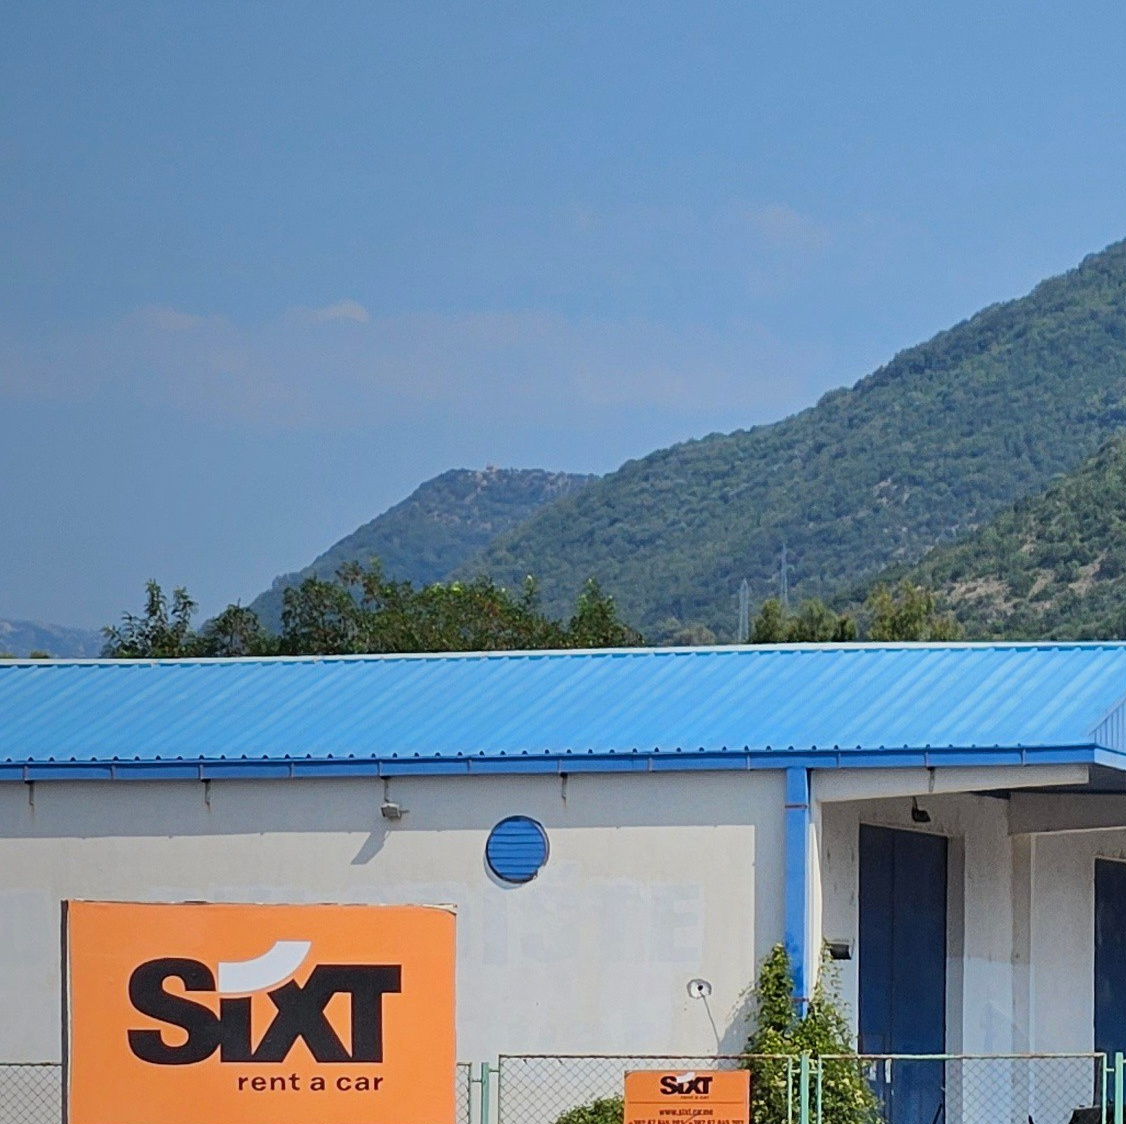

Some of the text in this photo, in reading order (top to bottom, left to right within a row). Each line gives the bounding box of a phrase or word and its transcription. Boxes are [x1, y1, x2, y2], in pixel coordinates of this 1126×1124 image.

[238, 1073, 384, 1091] rent a car
